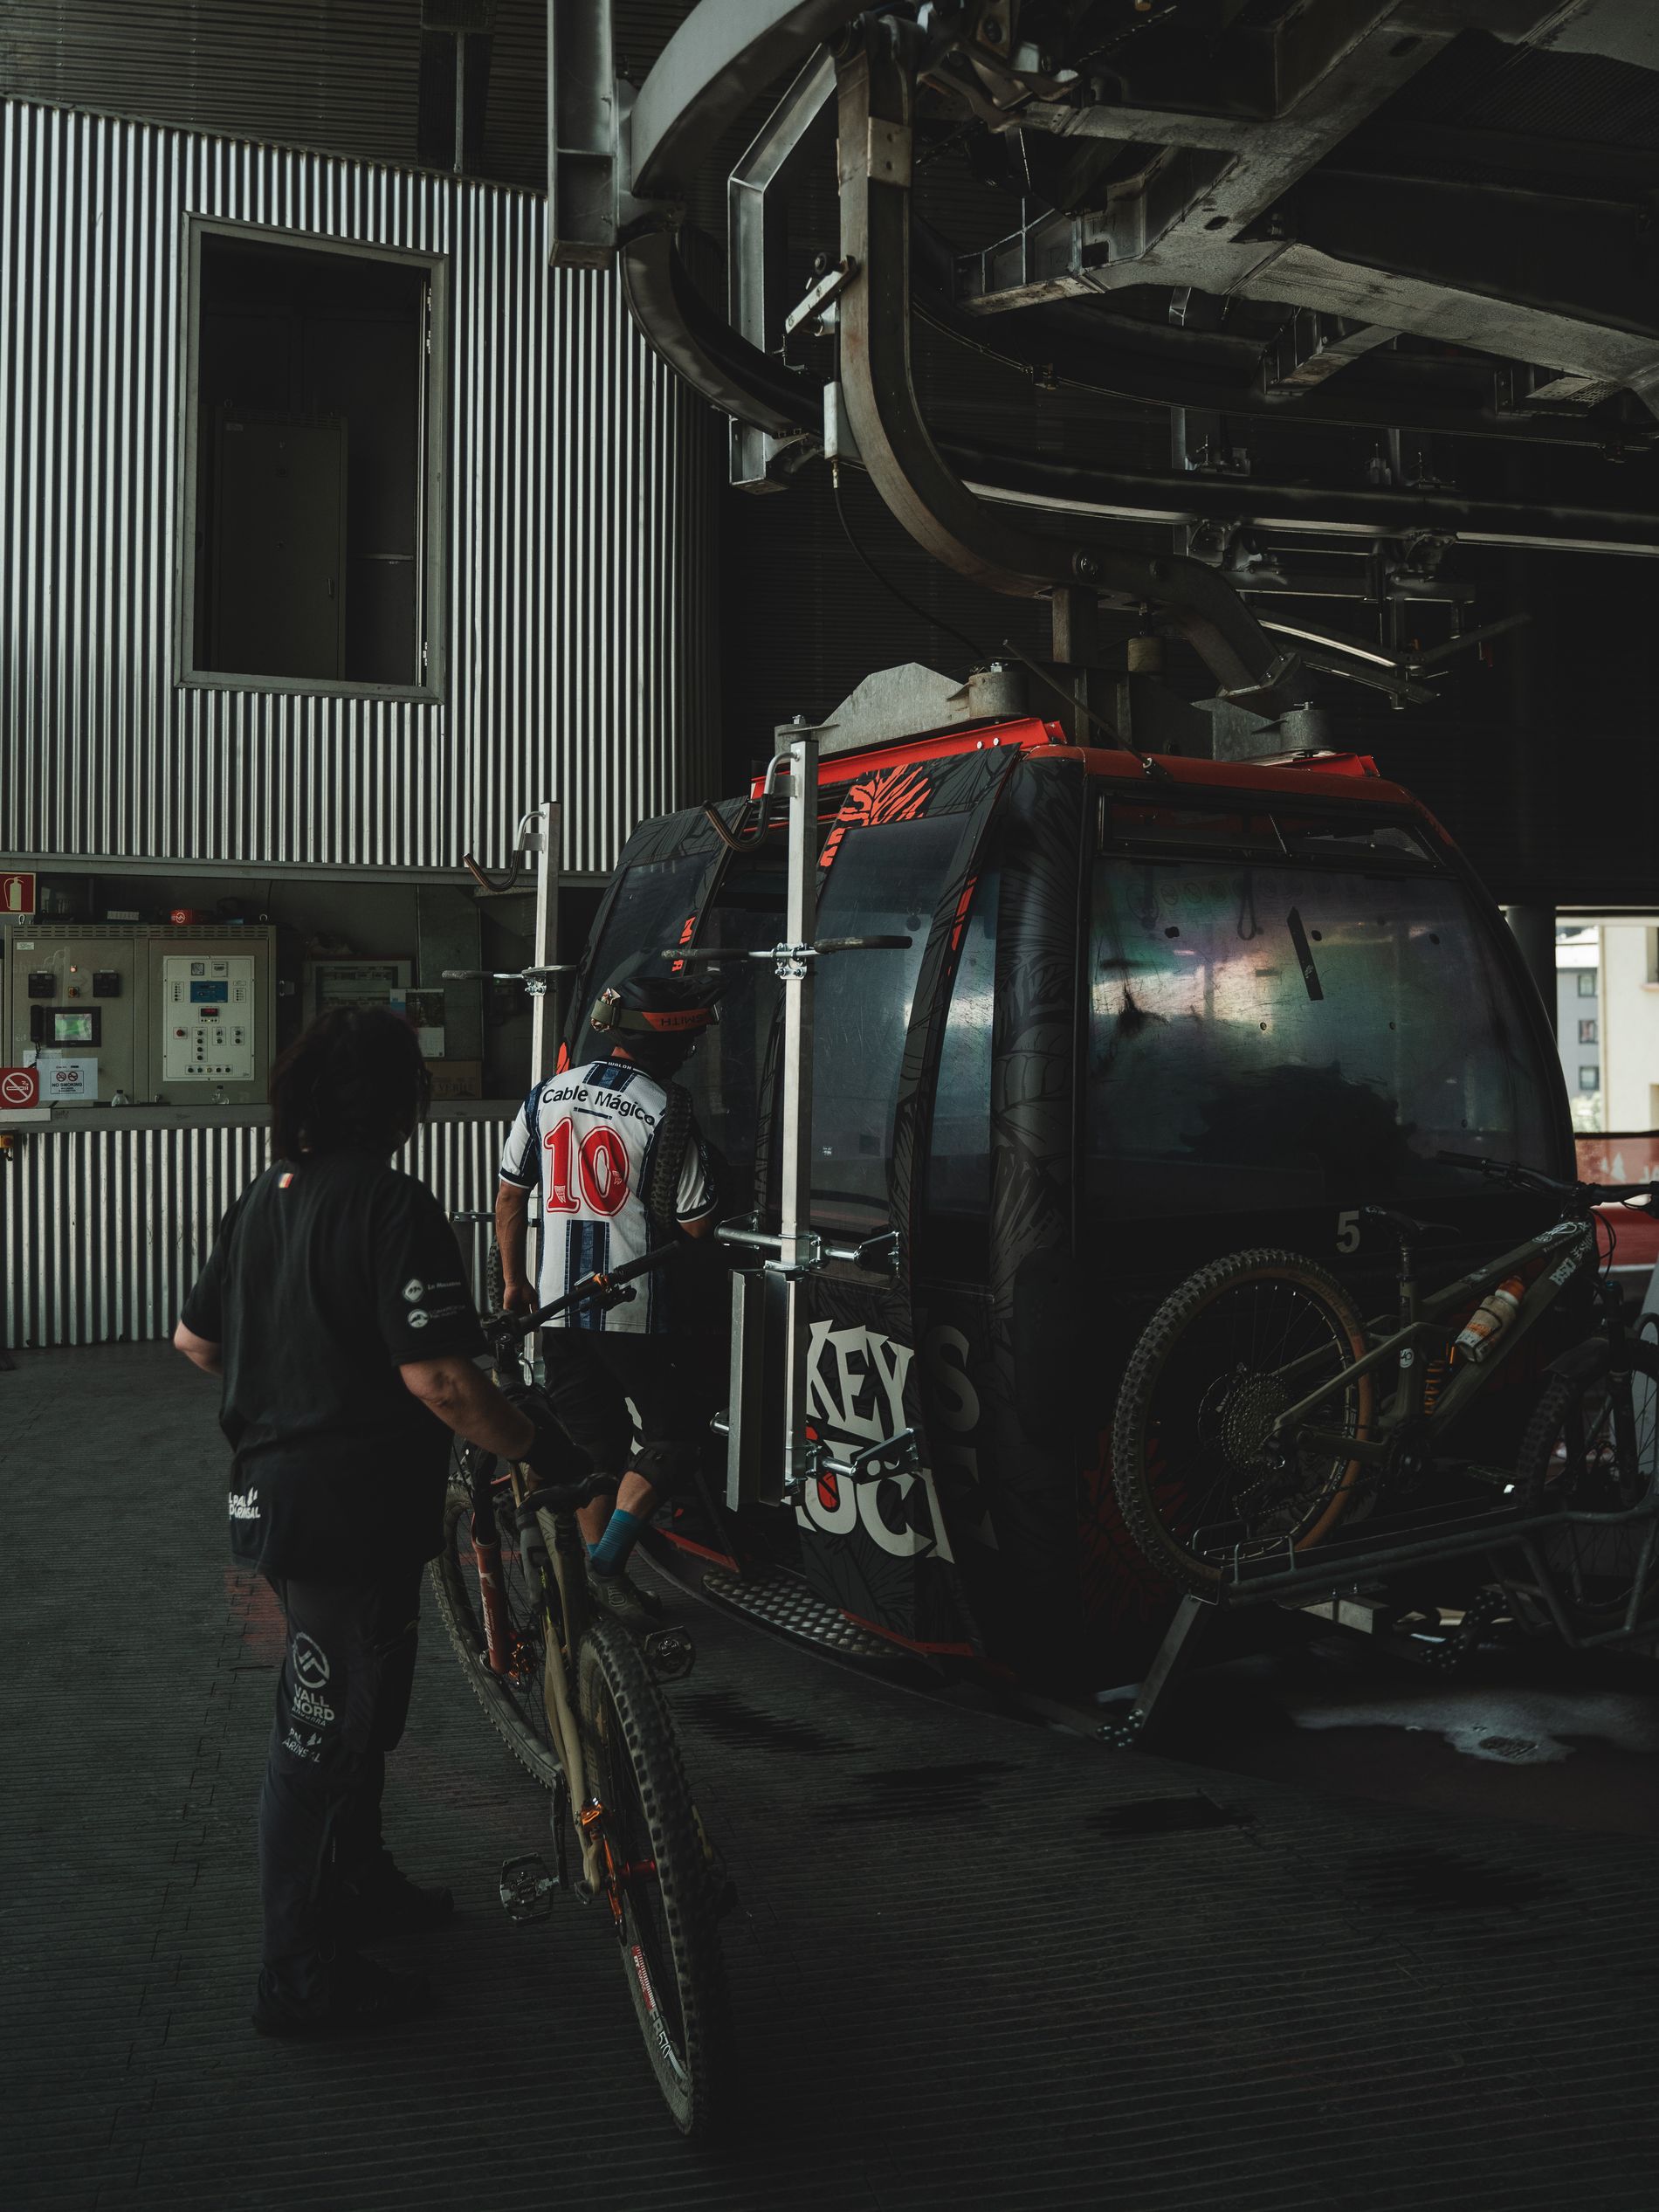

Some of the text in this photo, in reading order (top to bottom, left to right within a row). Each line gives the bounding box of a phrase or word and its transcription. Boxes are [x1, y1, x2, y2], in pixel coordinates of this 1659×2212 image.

[608, 1061, 632, 1071] WALON
[542, 1085, 656, 1127] Cable Mágico
[543, 1116, 630, 1217] 10
[1334, 1209, 1361, 1255] 5
[293, 1683, 330, 1708] VALL
[293, 1696, 335, 1721] NORD
